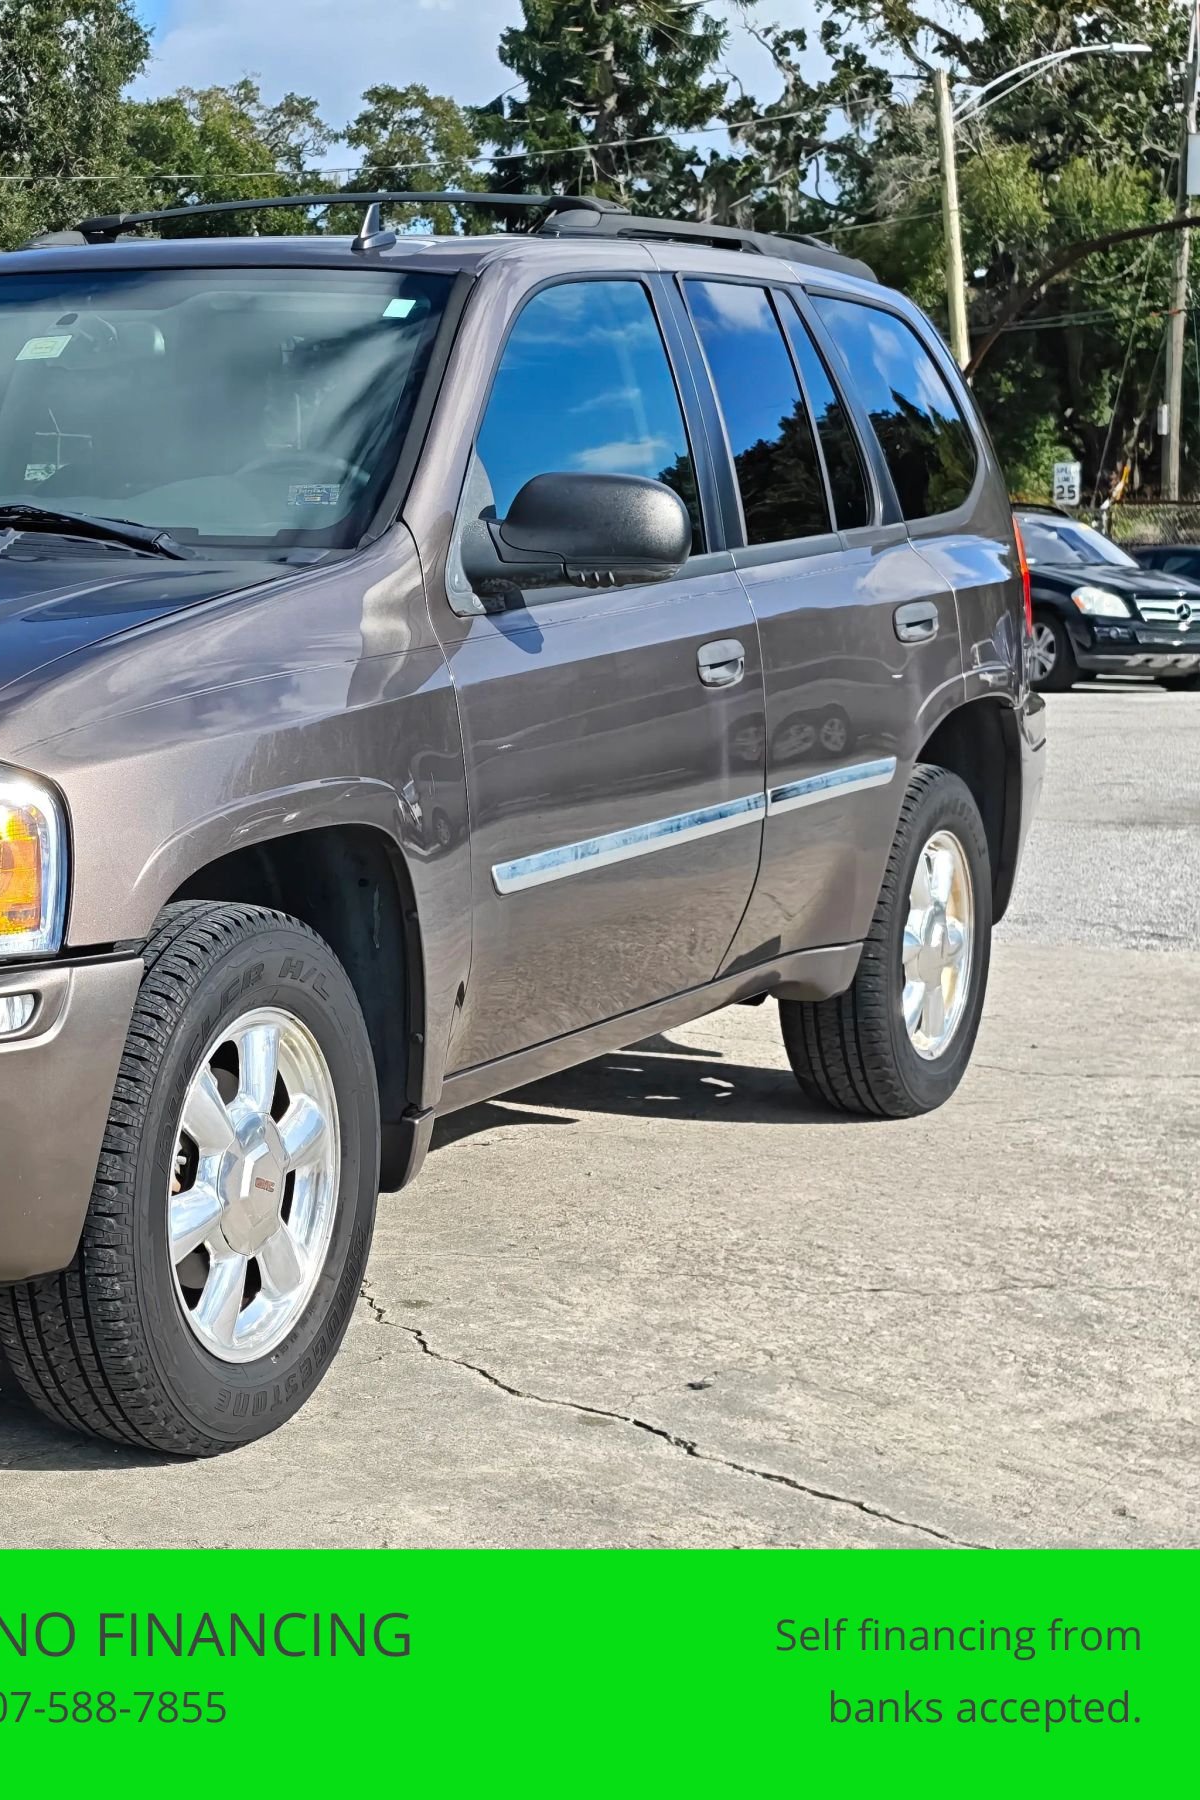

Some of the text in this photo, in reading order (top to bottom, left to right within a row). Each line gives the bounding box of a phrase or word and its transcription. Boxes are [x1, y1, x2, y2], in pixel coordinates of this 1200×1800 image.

[1056, 485, 1076, 500] 25
[278, 956, 330, 1001] H/L
[255, 1177, 276, 1193] GMC
[214, 1221, 368, 1417] BRIDGESTONE
